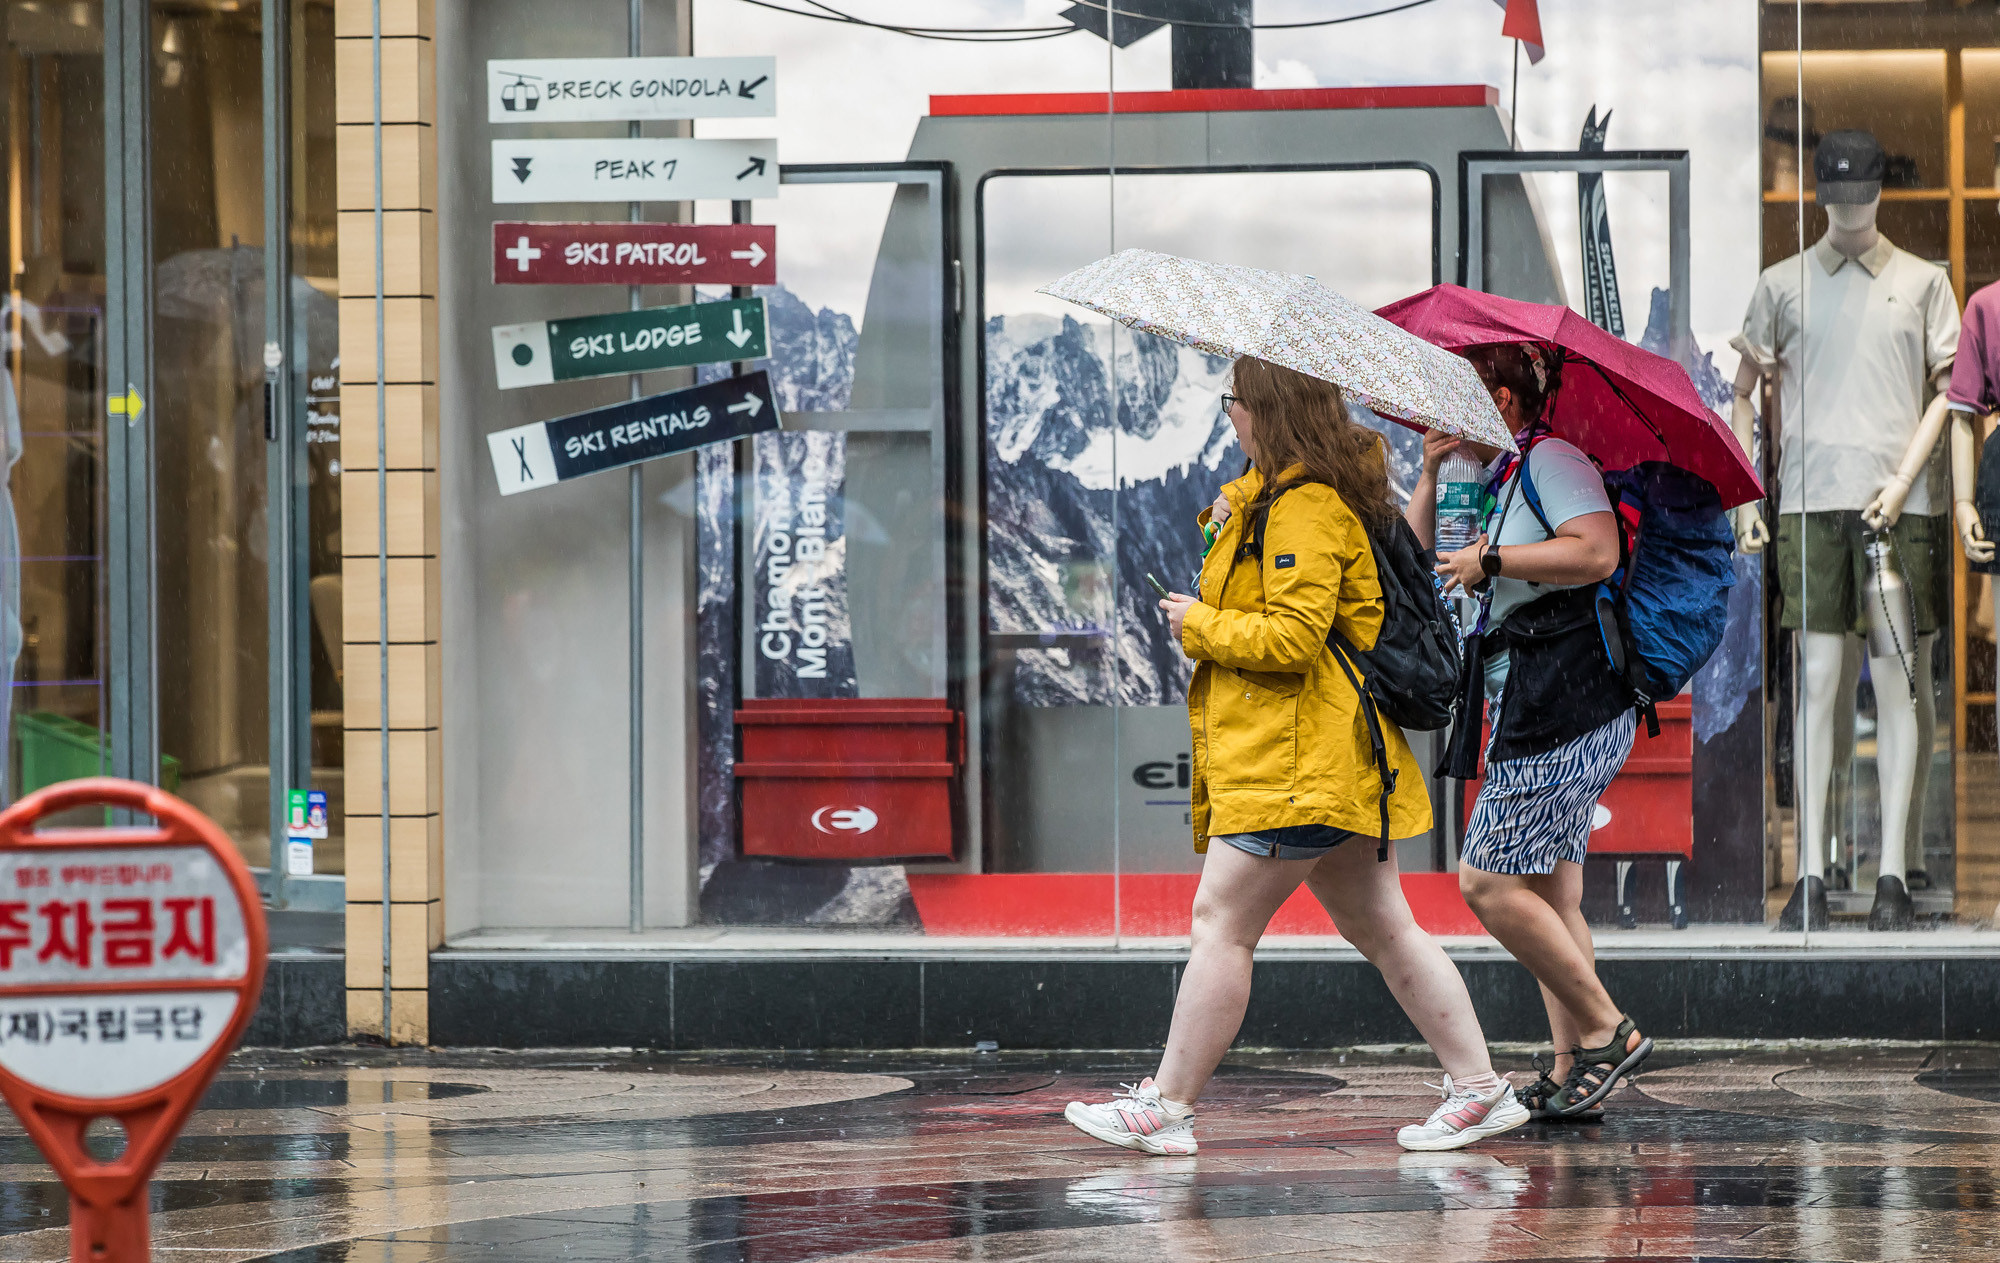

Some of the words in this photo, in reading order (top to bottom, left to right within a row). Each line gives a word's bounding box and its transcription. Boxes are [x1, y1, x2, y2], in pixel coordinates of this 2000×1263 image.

[548, 80, 623, 99] BRECK
[630, 78, 731, 98] GONDOLA
[594, 160, 655, 180] PEAK
[663, 159, 678, 180] 7
[564, 243, 608, 265] SKI
[615, 243, 707, 265] PATROL
[1600, 242, 1622, 331] SPLITKEIN
[569, 332, 615, 359] SKI
[619, 322, 703, 354] LODGE
[564, 430, 607, 459] SKI
[610, 405, 711, 442] RENTALS
[761, 476, 792, 660] Chamonix
[0, 896, 217, 970] 주차금지
